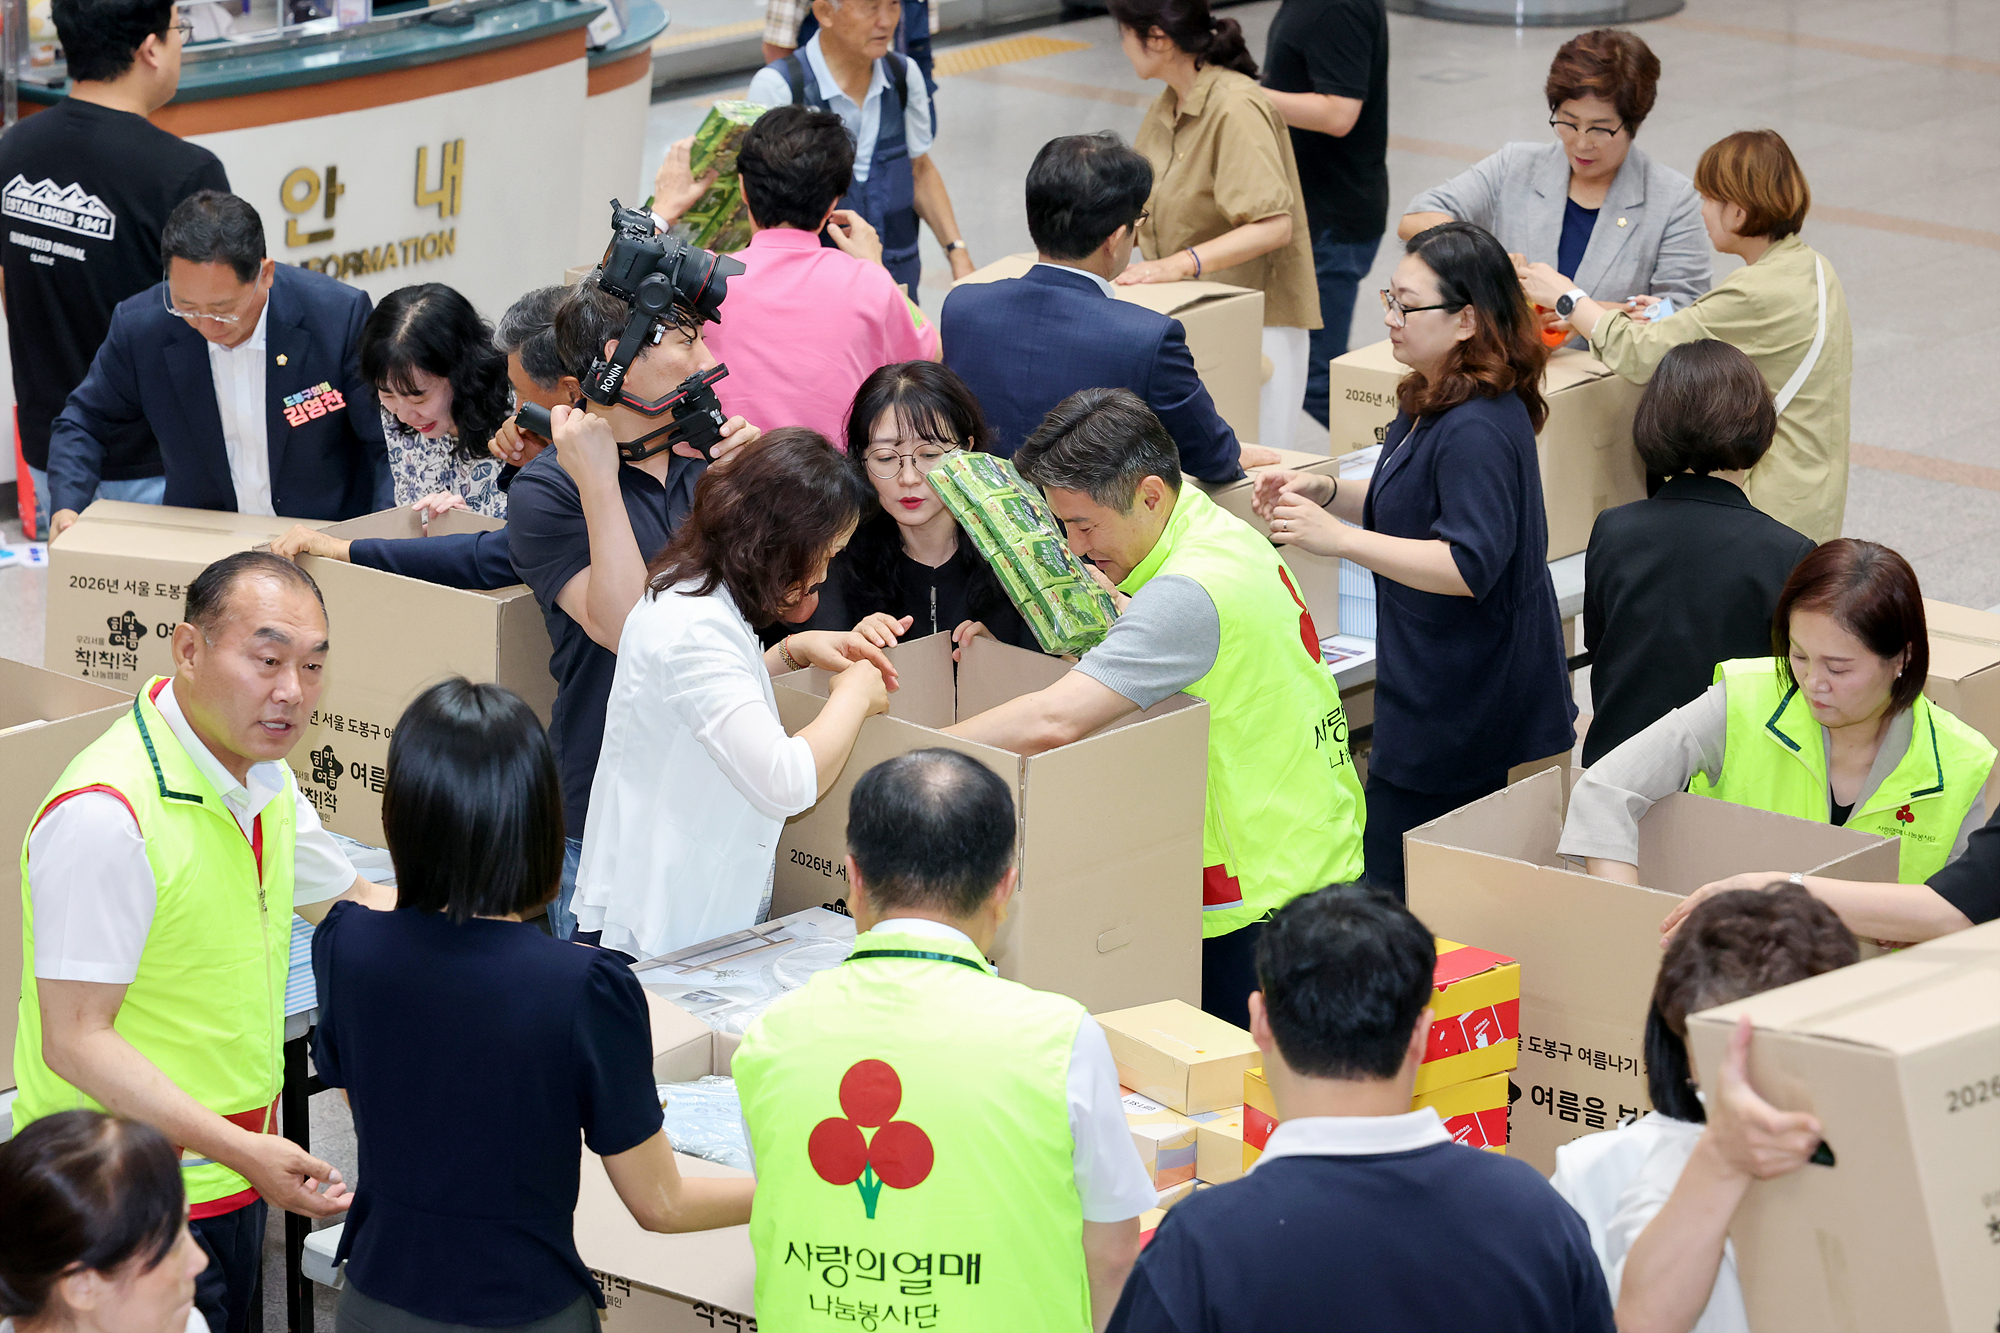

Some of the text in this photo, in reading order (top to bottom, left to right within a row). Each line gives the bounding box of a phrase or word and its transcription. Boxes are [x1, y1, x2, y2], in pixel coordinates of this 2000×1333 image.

[76, 215, 108, 233] 1941
[599, 363, 624, 393] RONIN
[283, 381, 332, 408] 도봉구의원
[283, 388, 347, 428] 김영찬
[1345, 388, 1382, 407] 2026년
[69, 575, 119, 594] 2026년
[124, 580, 150, 597] 서울
[322, 712, 345, 732] 서울
[348, 718, 381, 740] 도봉구
[790, 848, 832, 877] 2026년
[1527, 1035, 1574, 1062] 도봉구
[1577, 1047, 1638, 1077] 여름나기
[1531, 1085, 1608, 1130] 여름을
[784, 1241, 981, 1296] 사랑의열매
[809, 1294, 940, 1332] 나눔봉사단
